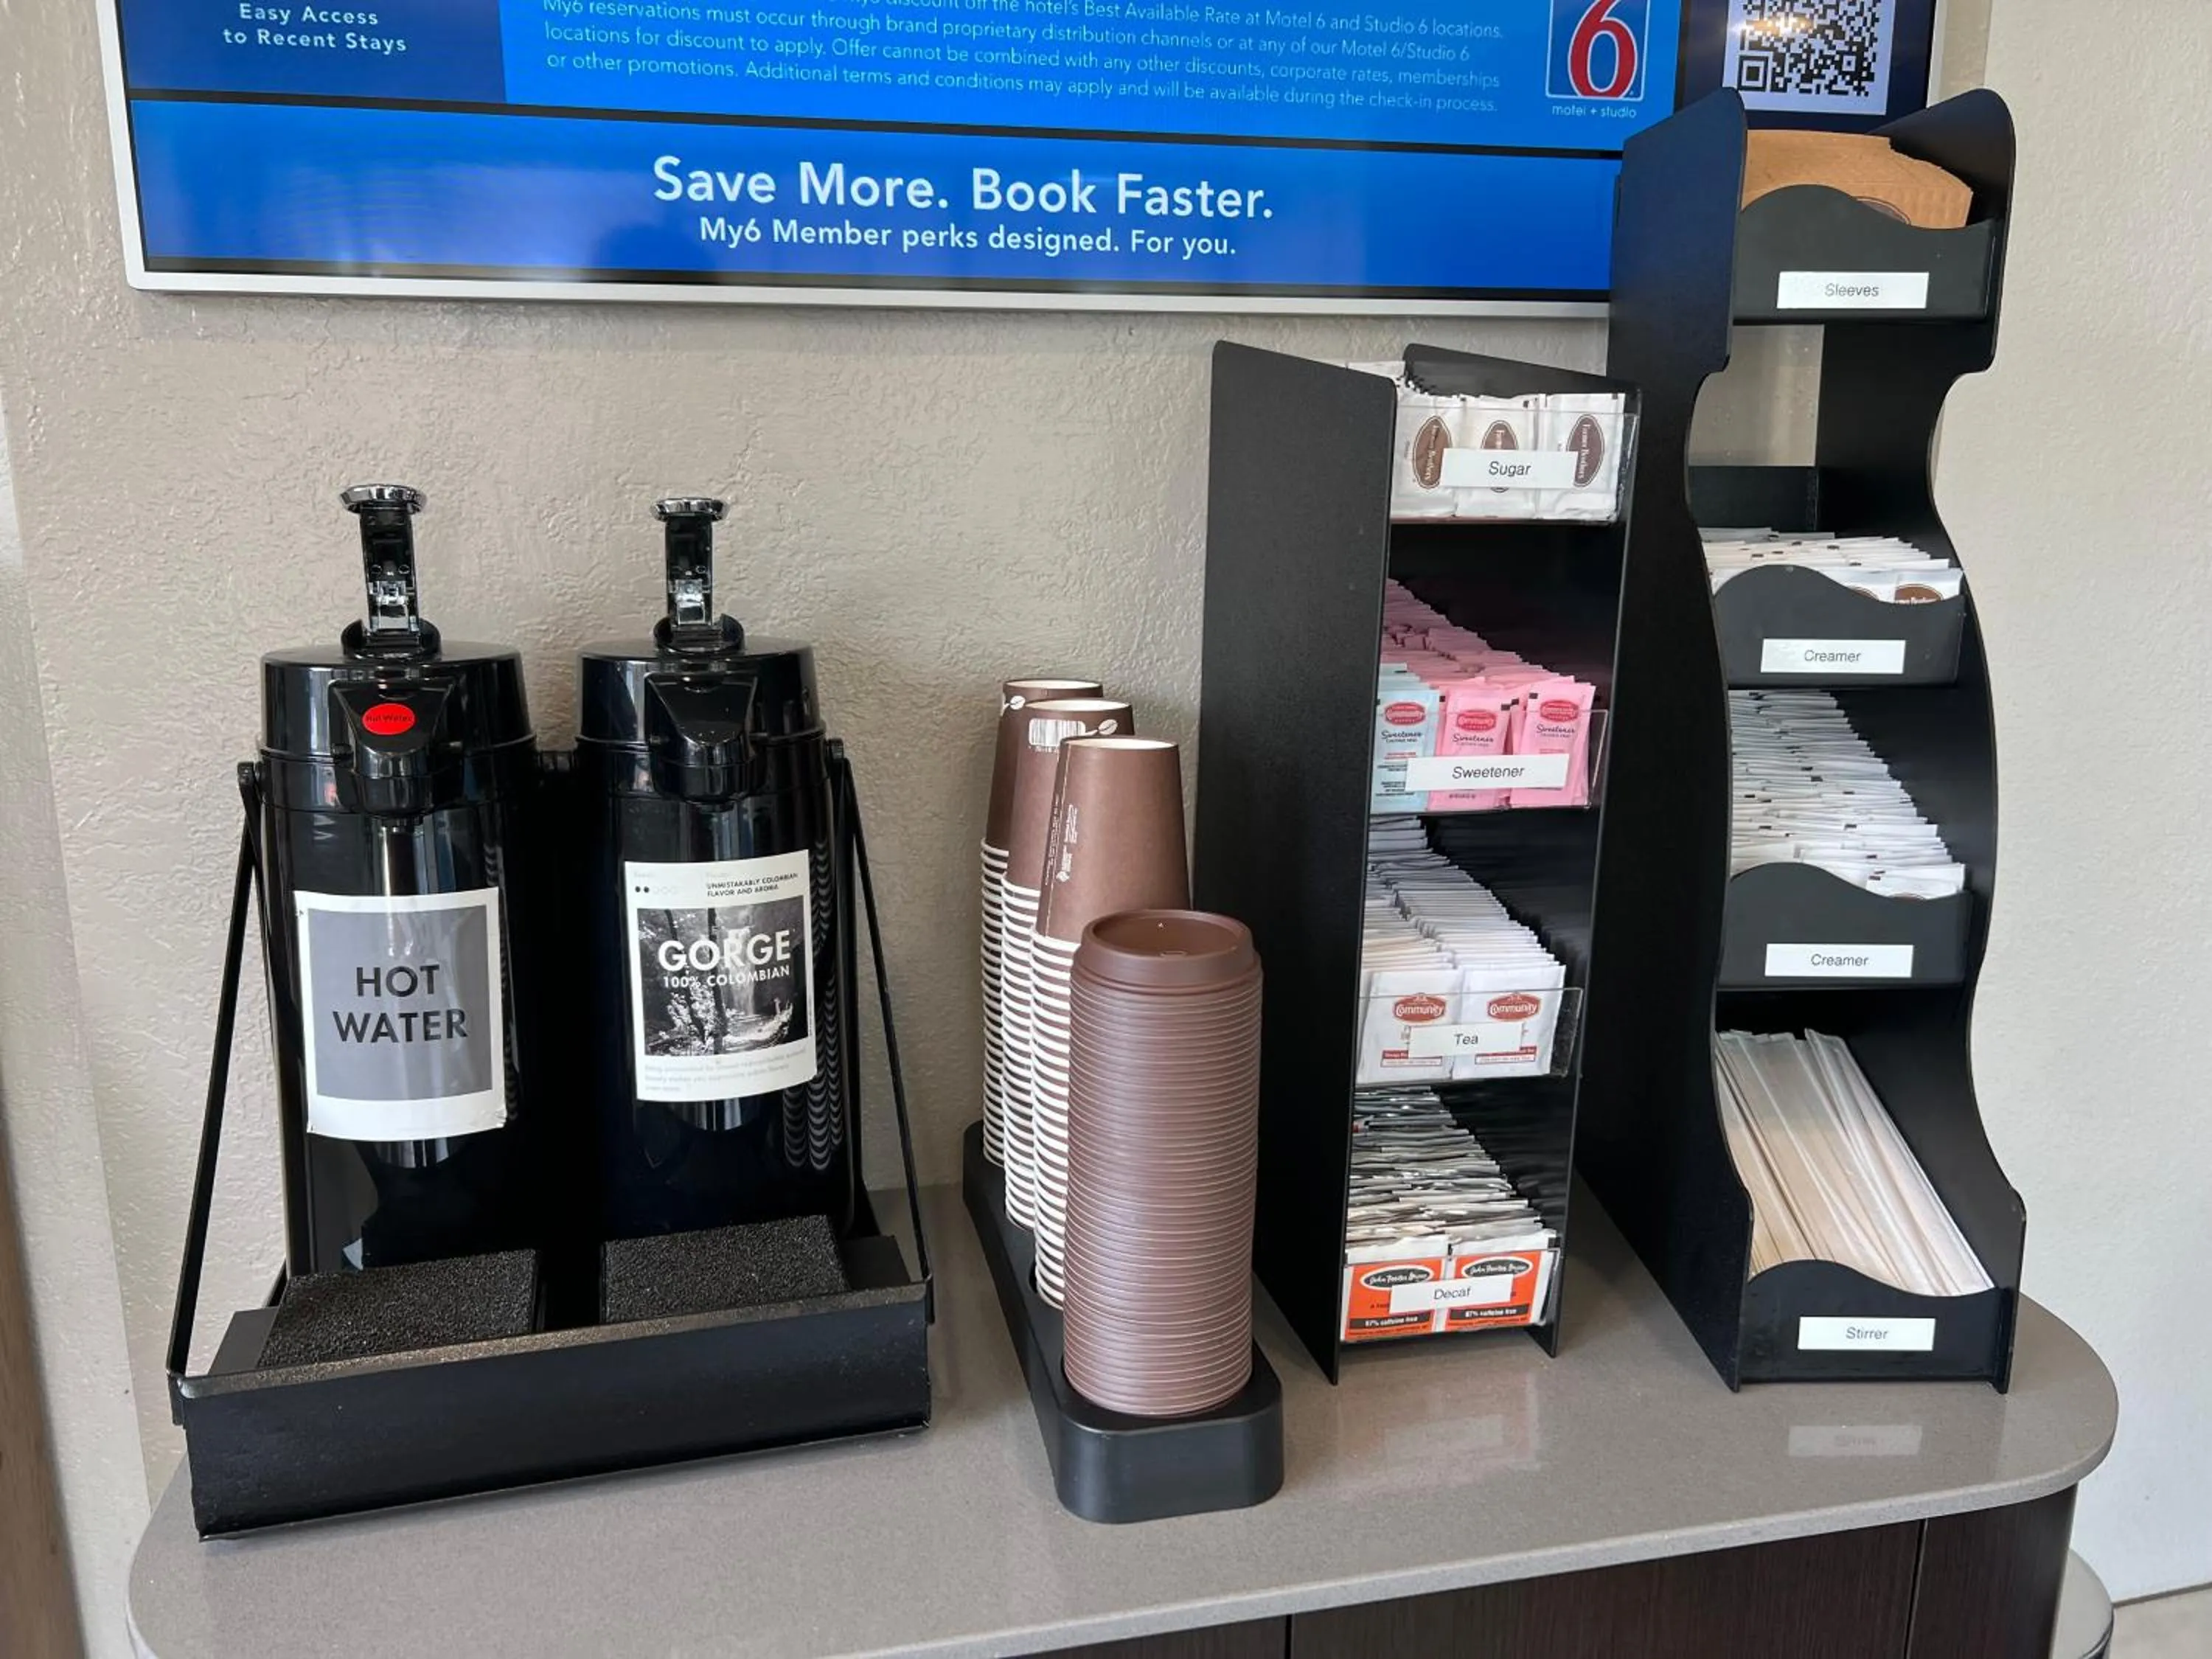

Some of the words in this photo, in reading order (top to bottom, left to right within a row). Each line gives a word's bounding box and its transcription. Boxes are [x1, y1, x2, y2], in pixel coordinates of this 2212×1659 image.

[239, 3, 291, 25] Easy
[301, 6, 378, 25] Access
[993, 0, 1019, 12] the
[1026, 0, 1079, 15] hotel's
[1085, 1, 1121, 18] Best
[1125, 2, 1200, 22] Available
[1206, 7, 1240, 24] Rate
[1246, 13, 1260, 25] at
[1266, 10, 1312, 28] Motel
[1316, 13, 1326, 29] 6
[1330, 15, 1360, 31] and
[1365, 15, 1415, 34] Studio
[1419, 18, 1428, 35] 6
[1433, 18, 1503, 38] locations.
[543, 0, 583, 17] My6
[591, 1, 700, 21] reservations
[706, 7, 751, 24] must
[757, 11, 804, 26] occur
[812, 10, 880, 35] through
[886, 14, 937, 34] brand
[943, 21, 1036, 44] proprietary
[1042, 23, 1136, 45] distribution
[1141, 29, 1212, 49] channels
[1217, 37, 1234, 49] or
[1239, 36, 1253, 51] at
[1259, 39, 1286, 57] any
[1291, 36, 1307, 53] of
[1310, 41, 1338, 55] our
[1342, 39, 1386, 57] Motel
[1391, 41, 1455, 60] 6/Studio
[1460, 46, 1470, 61] 6
[223, 29, 247, 44] to
[257, 29, 336, 48] Recent
[345, 32, 407, 55] Stays
[1568, 0, 1638, 100] 6
[545, 20, 630, 44] locations
[636, 27, 661, 46] for
[667, 30, 745, 51] discount
[751, 37, 769, 52] to
[774, 37, 827, 58] apply.
[832, 38, 877, 58] Offer
[883, 45, 942, 61] cannot
[947, 44, 969, 62] be
[974, 46, 1060, 66] combined
[1065, 50, 1098, 69] with
[1104, 57, 1131, 74] any
[1137, 55, 1179, 72] other
[1185, 56, 1265, 78] discounts,
[1270, 63, 1347, 82] corporate
[1352, 68, 1393, 84] rates,
[1398, 69, 1500, 90] memberships
[547, 54, 566, 68] or
[573, 51, 622, 70] other
[628, 58, 739, 77] promotions.
[745, 60, 838, 82] Additional
[844, 68, 891, 85] terms
[897, 71, 930, 86] and
[935, 71, 1024, 91] conditions
[1029, 80, 1062, 97] may
[1068, 77, 1113, 98] apply
[1119, 80, 1148, 96] and
[1153, 80, 1179, 97] will
[1184, 81, 1204, 99] be
[1210, 83, 1279, 102] available
[1284, 87, 1335, 108] during
[1340, 90, 1365, 105] the
[1369, 89, 1432, 108] check-in
[1436, 95, 1498, 113] process.
[1552, 104, 1586, 116] motel
[1601, 106, 1637, 119] studio
[653, 156, 776, 204] Save
[799, 161, 949, 209] More.
[972, 168, 1096, 214] Book
[1118, 173, 1273, 219] Faster.
[700, 218, 760, 246] My6
[773, 219, 891, 246] Member
[902, 224, 978, 251] perks
[989, 226, 1120, 255] designed.
[1130, 229, 1173, 254] For
[1183, 236, 1237, 259] you.
[1824, 282, 1879, 298] Sleeves
[1489, 461, 1532, 476] Sugar
[1804, 650, 1861, 663] Creamer
[1452, 765, 1525, 779] Sweetener
[707, 888, 734, 897] FLAVOR
[737, 886, 753, 895] AND
[754, 884, 779, 893] AROMA
[658, 929, 791, 972] GORGE
[1811, 954, 1868, 967] Creamer
[356, 964, 440, 998] HOT
[663, 975, 701, 989] 100%
[707, 964, 790, 987] COLOMBIAN
[1396, 1004, 1444, 1017] Community
[1490, 1003, 1537, 1015] Community
[333, 1009, 469, 1043] WATER
[1454, 1033, 1478, 1046] Tea
[1433, 1287, 1472, 1299] Decaf
[1846, 1326, 1888, 1340] Stirrer
